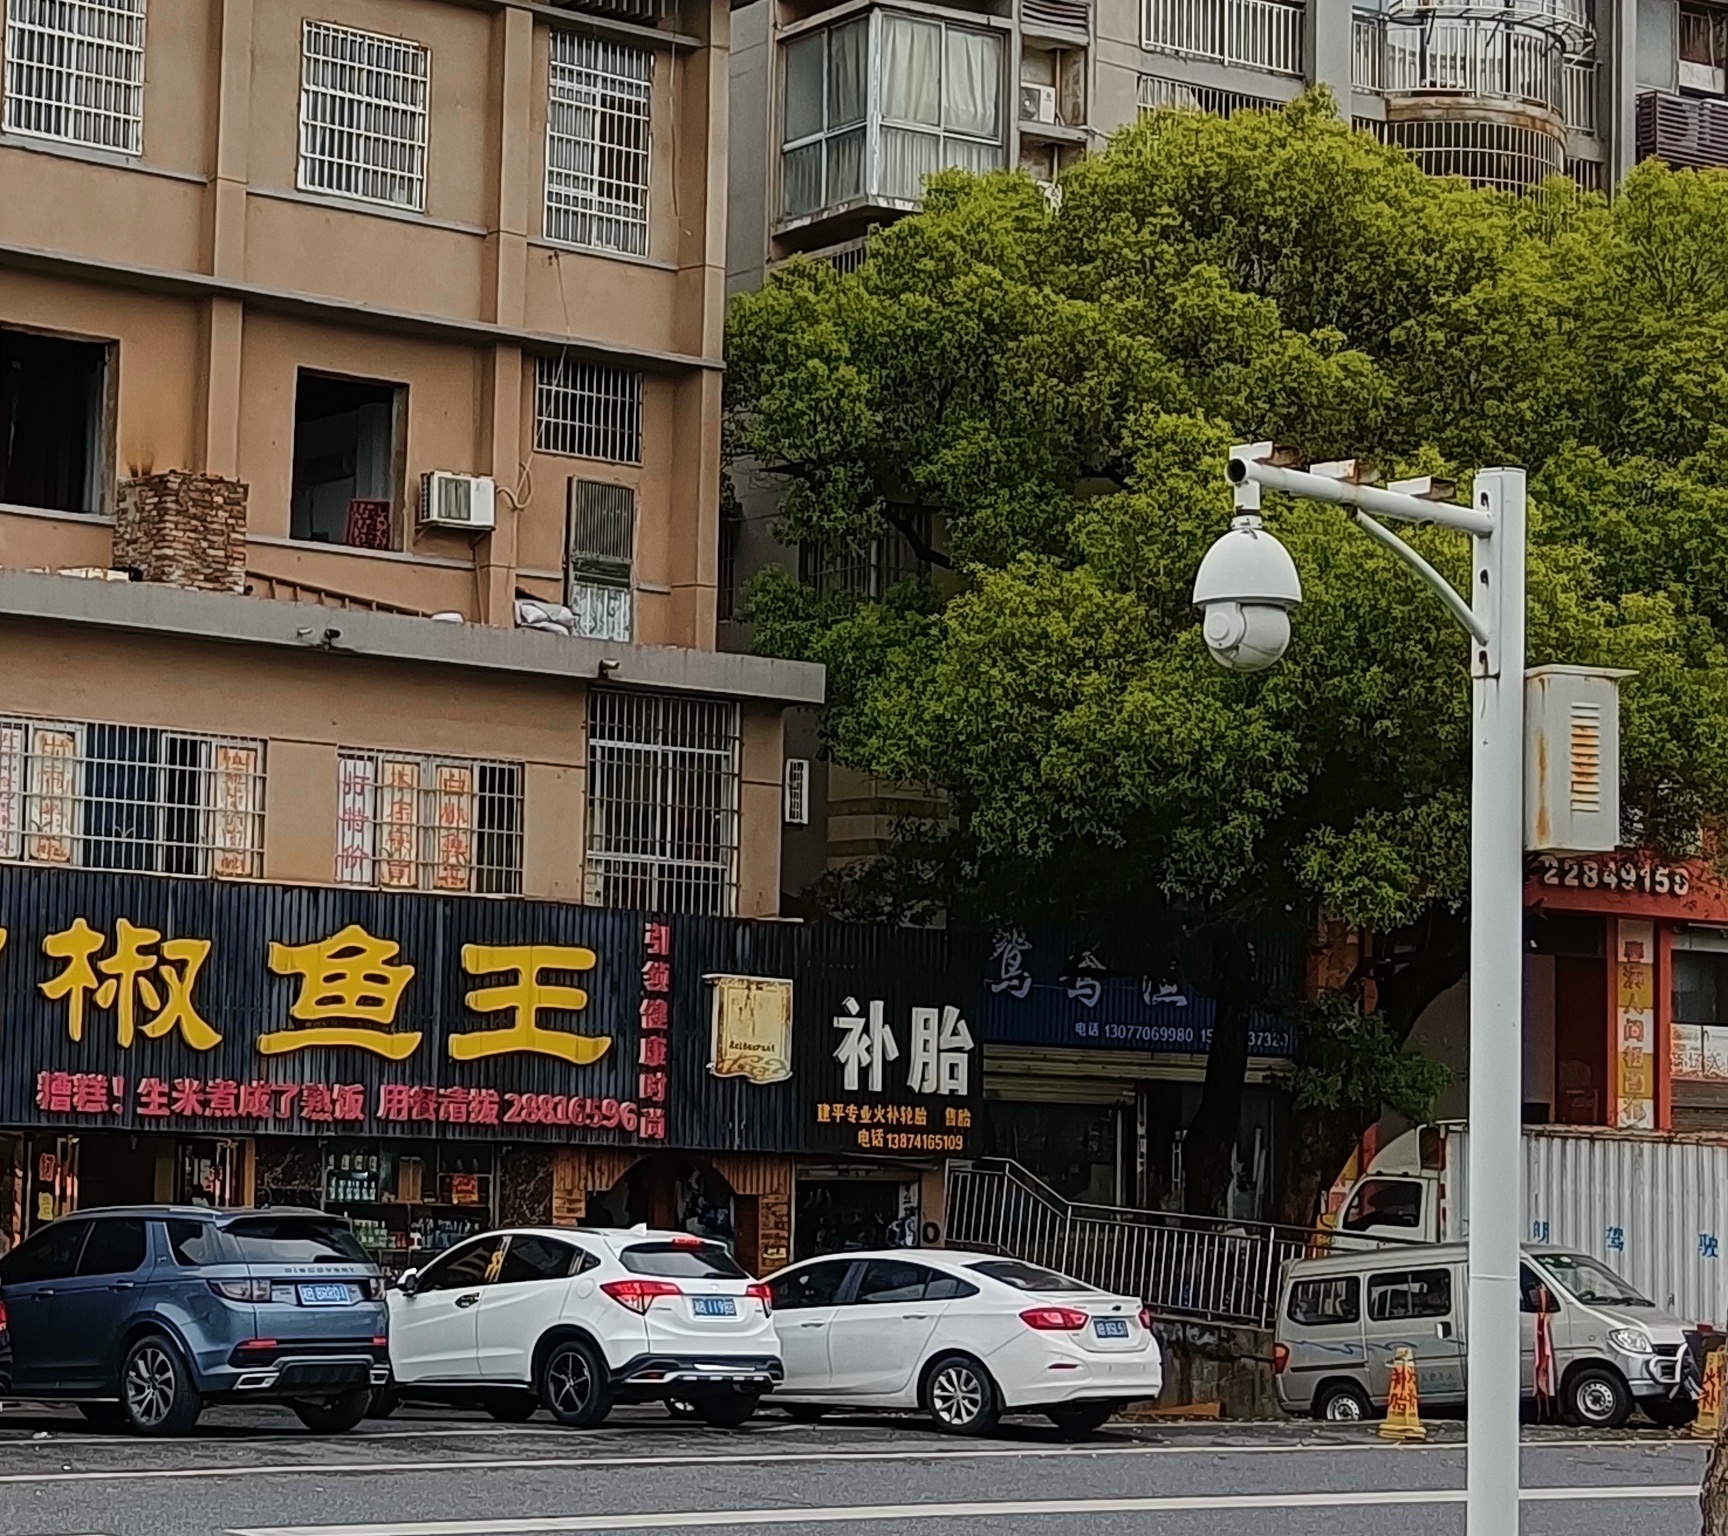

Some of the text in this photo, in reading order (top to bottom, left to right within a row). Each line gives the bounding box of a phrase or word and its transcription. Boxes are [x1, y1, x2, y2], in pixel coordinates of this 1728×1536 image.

[638, 922, 670, 1139] 引领健康时尚
[832, 996, 974, 1096] 补胎
[1075, 1022, 1099, 1037] 电话
[1104, 1024, 1194, 1043] 13077069980
[136, 1076, 366, 1123] 生米煮成了熟饭
[816, 1103, 972, 1128] 建平专业火补轮胎 售胎
